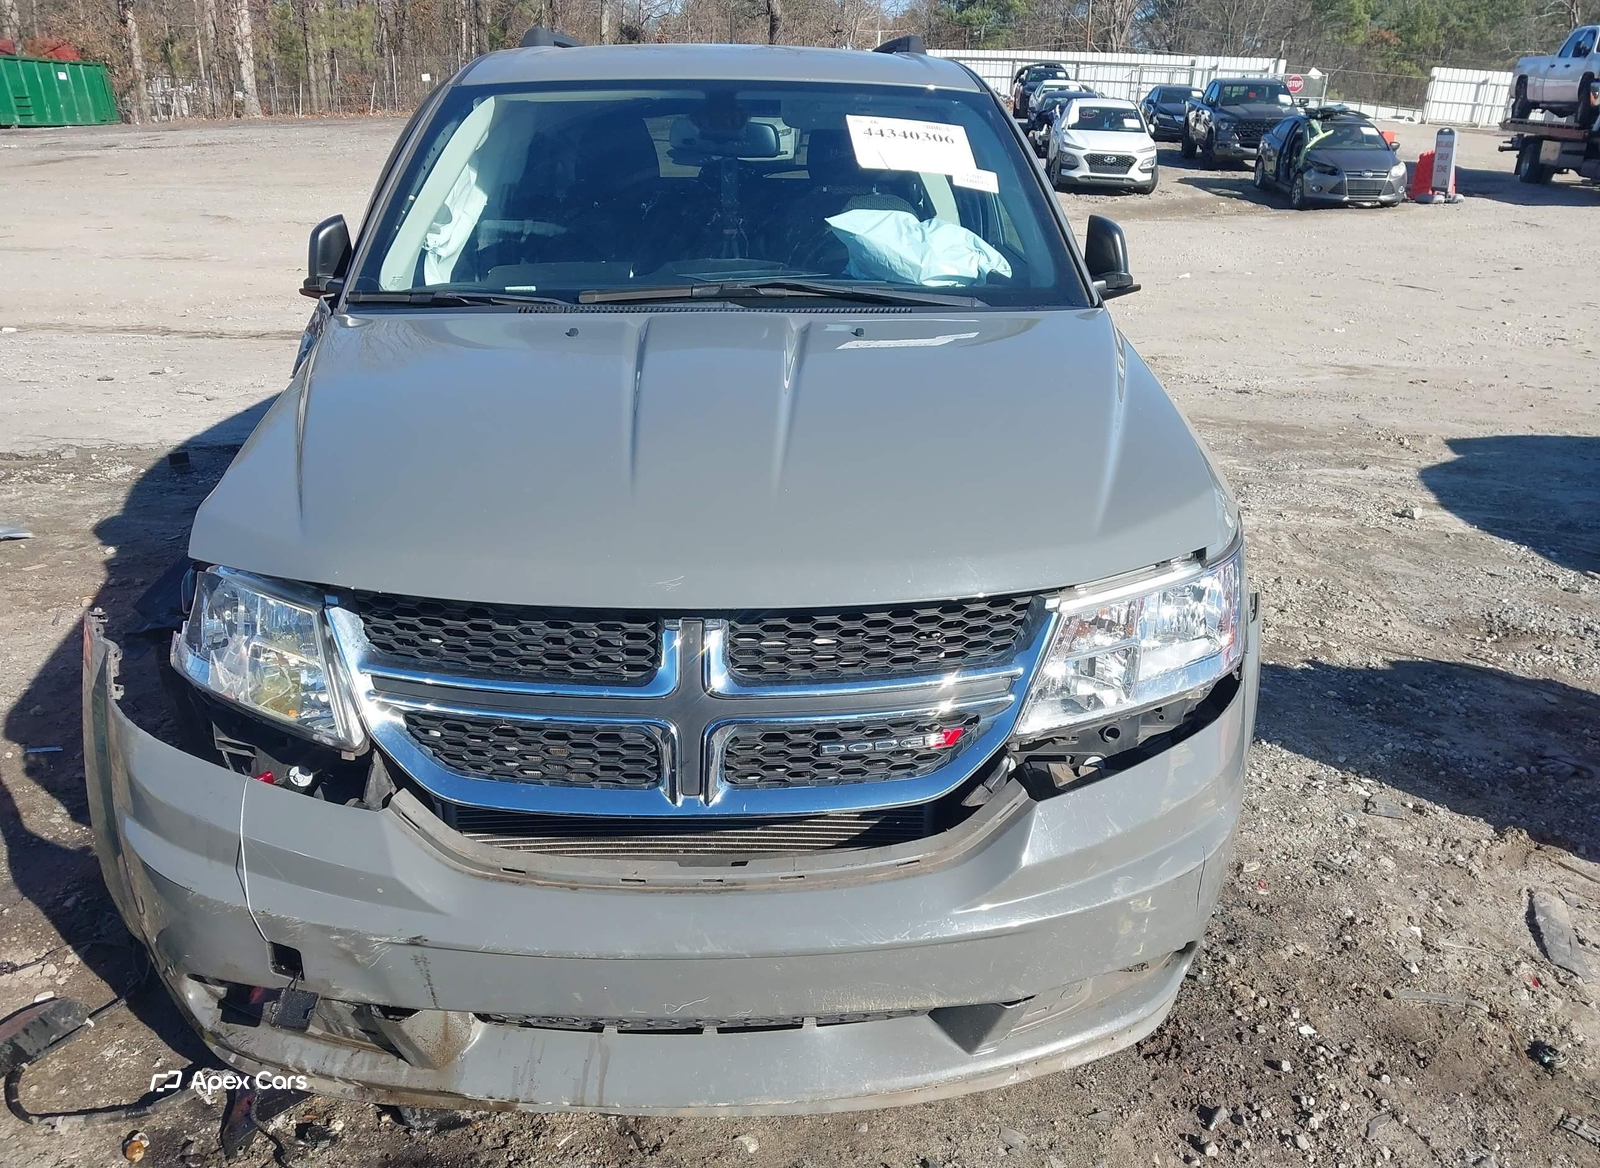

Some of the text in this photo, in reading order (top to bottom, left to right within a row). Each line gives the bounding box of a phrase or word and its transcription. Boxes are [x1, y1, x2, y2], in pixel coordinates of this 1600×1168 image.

[1289, 80, 1302, 88] STOP
[863, 127, 955, 144] 44340306
[821, 733, 945, 755] DODGE
